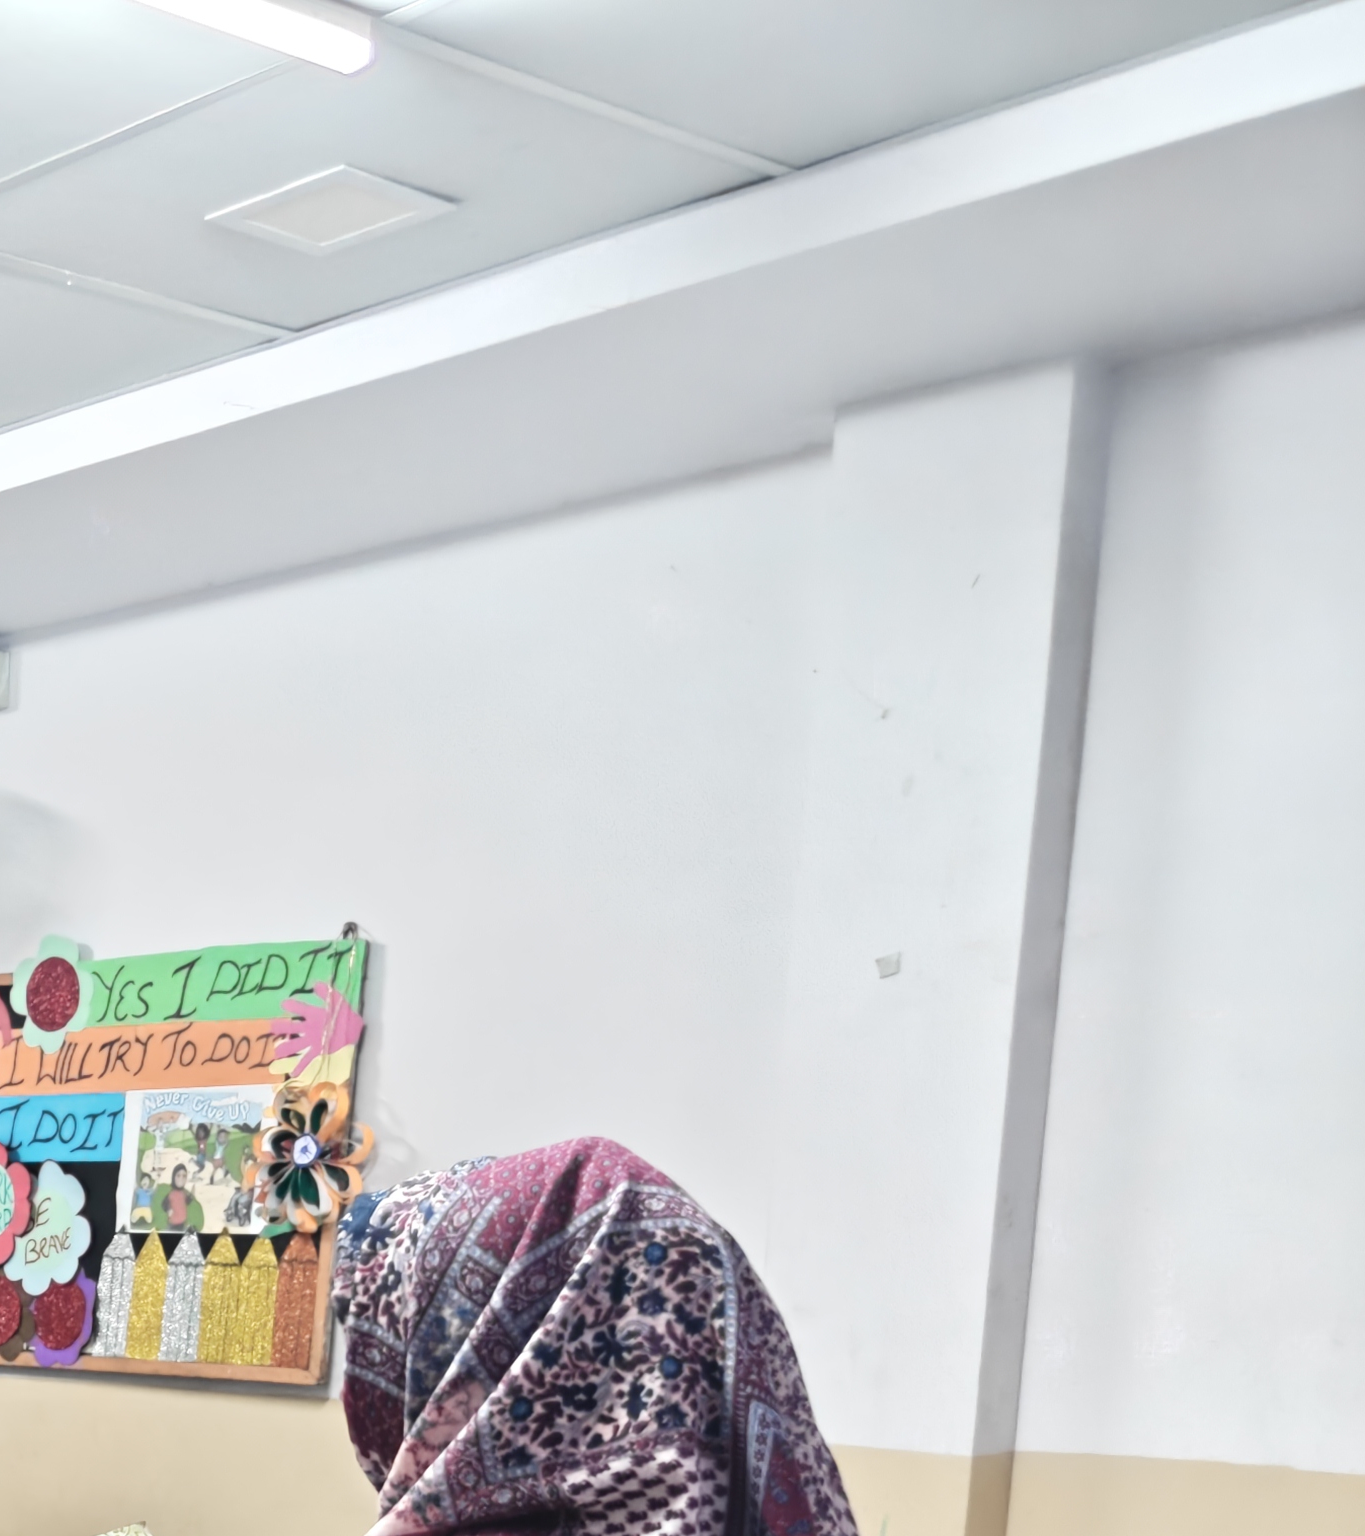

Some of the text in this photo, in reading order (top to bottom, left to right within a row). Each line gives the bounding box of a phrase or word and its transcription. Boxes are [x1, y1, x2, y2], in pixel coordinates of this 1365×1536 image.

[91, 965, 154, 1022] YES
[162, 956, 202, 1021] I
[206, 953, 289, 1001] DID
[35, 1040, 94, 1086] WILL
[98, 1033, 154, 1079] TRY
[161, 1022, 197, 1070] TO
[25, 1226, 72, 1267] BRAVE
